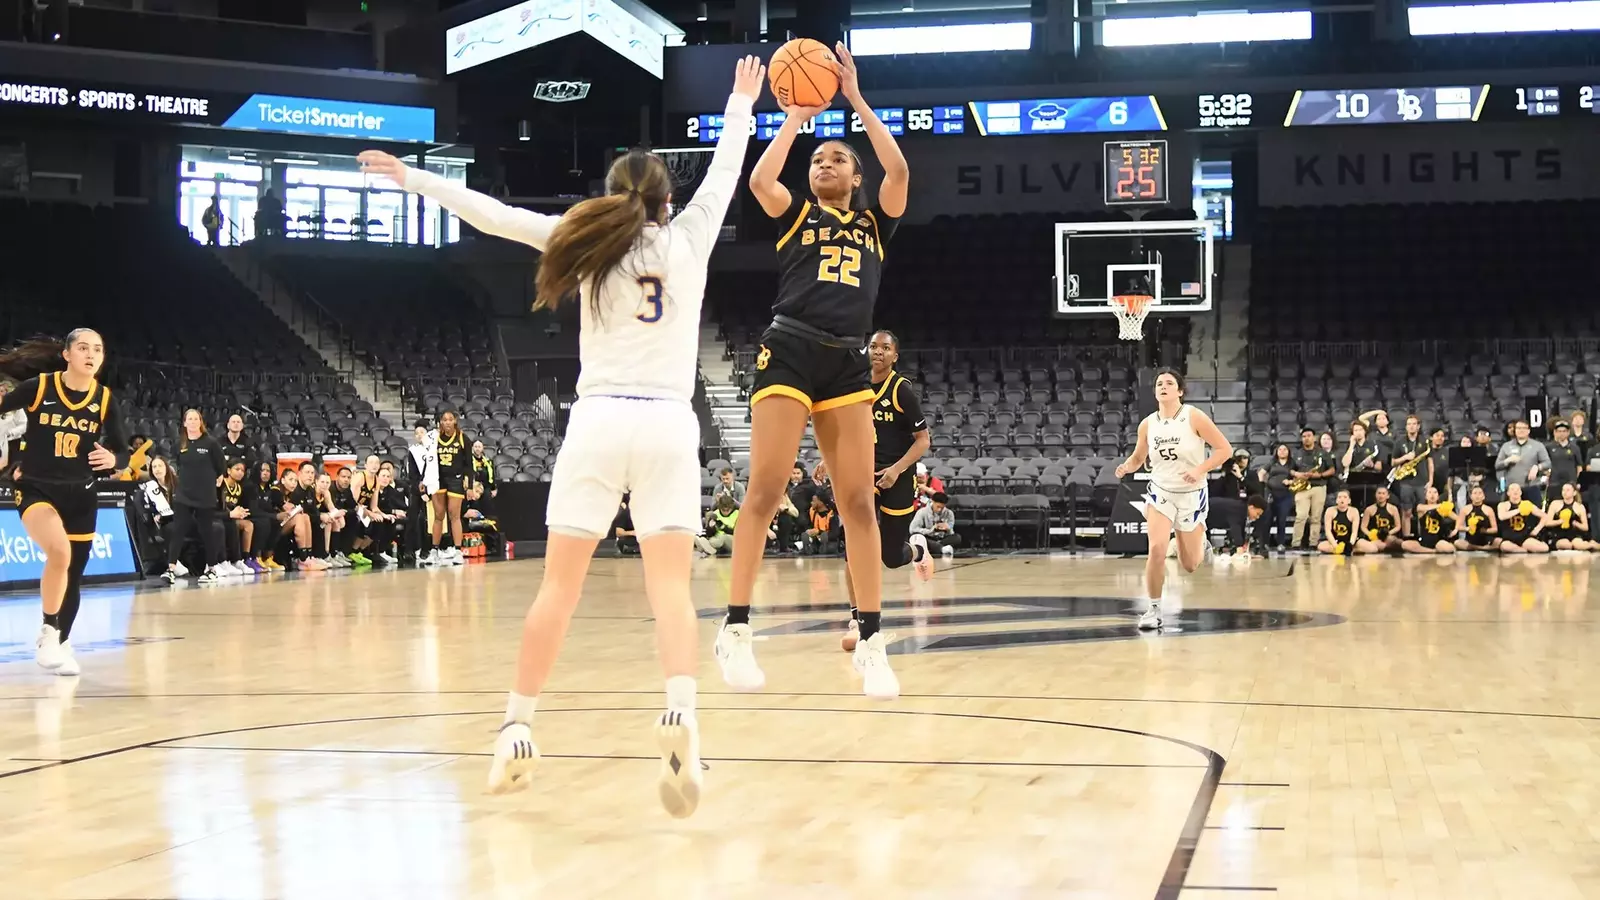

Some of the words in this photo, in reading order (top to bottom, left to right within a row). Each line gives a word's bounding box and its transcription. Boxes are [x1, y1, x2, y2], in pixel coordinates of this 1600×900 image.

[0, 83, 69, 105] ONCERTS
[79, 90, 135, 111] SPORTS
[146, 95, 208, 116] THEATRE
[1199, 94, 1252, 116] 5:32
[1335, 93, 1369, 119] 10
[1580, 86, 1593, 108] 2
[258, 104, 385, 130] TicketSmarter
[908, 109, 933, 130] 55
[1109, 102, 1128, 125] 6
[687, 117, 700, 138] 2
[1295, 149, 1561, 186] KNIGHTS
[1117, 166, 1156, 197] 25
[801, 227, 875, 253] BEACH
[817, 246, 862, 288] 22
[637, 275, 663, 323] 3
[39, 412, 99, 433] BEACH
[1530, 409, 1542, 428] D
[55, 431, 80, 458] 10
[1159, 448, 1178, 461] 55
[1113, 522, 1139, 534] THE
